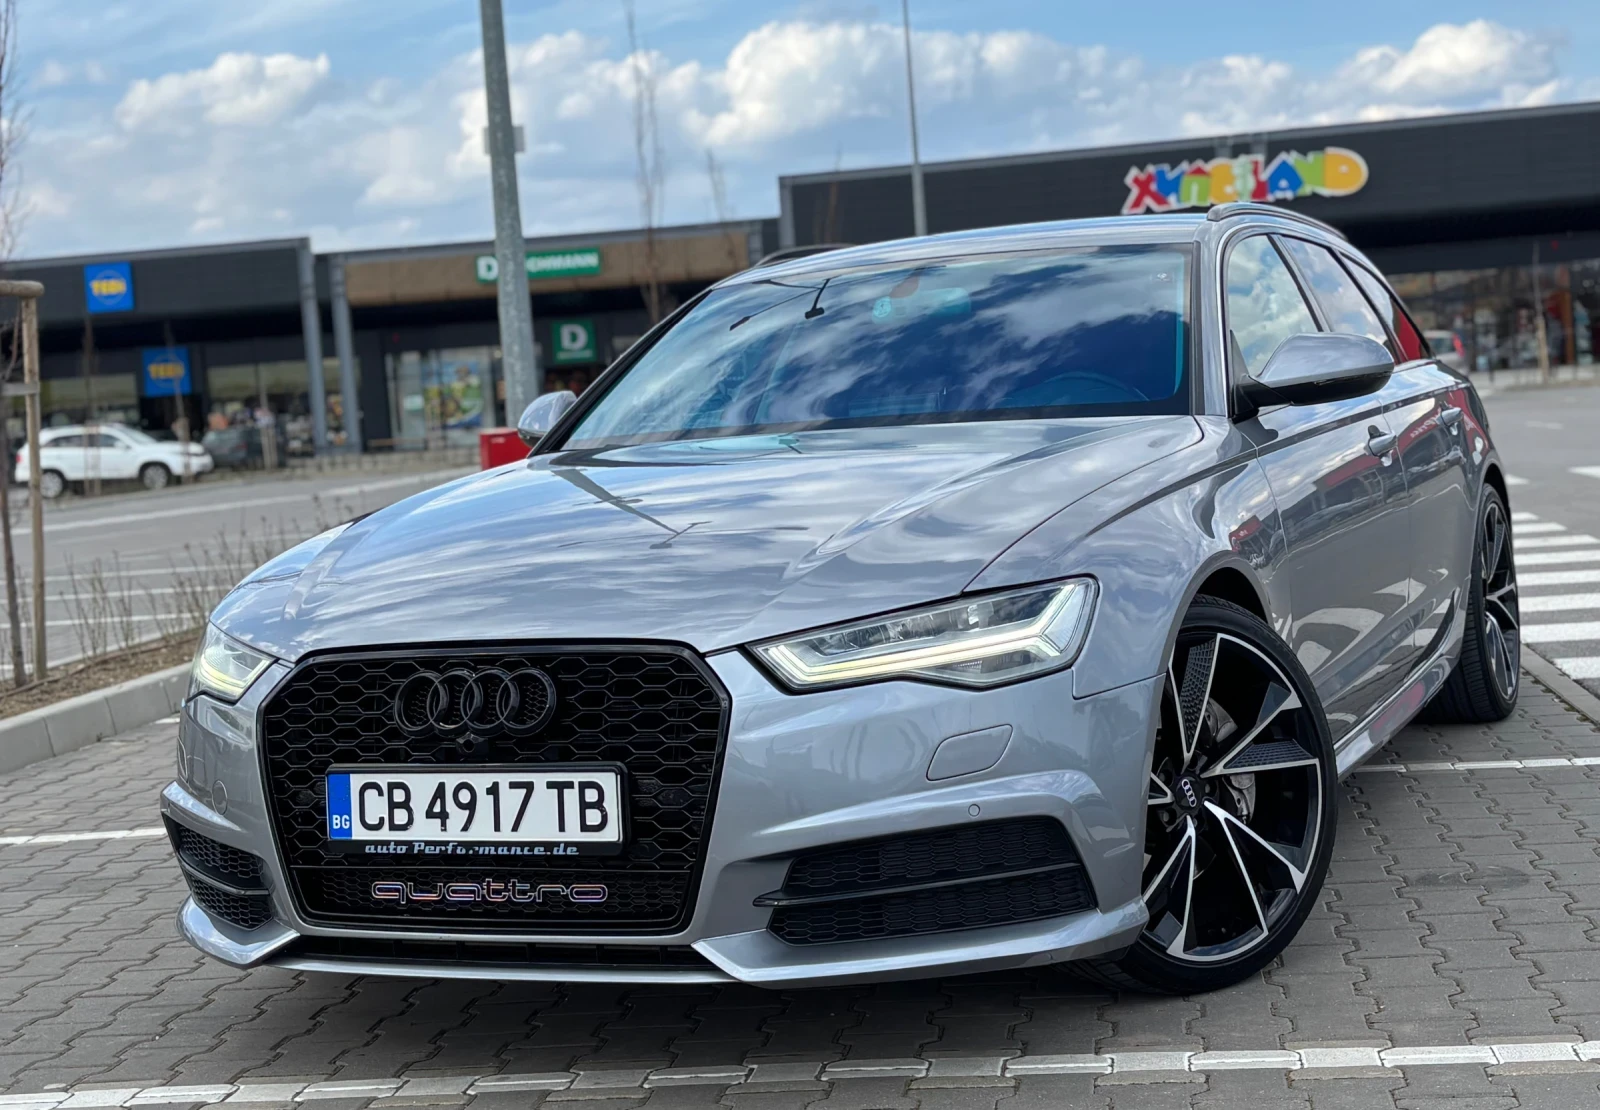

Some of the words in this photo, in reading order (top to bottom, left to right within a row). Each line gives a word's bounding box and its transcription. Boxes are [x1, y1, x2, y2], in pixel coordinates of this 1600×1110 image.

[560, 323, 588, 351] D
[358, 781, 414, 831] CB
[425, 781, 535, 832] 4917
[546, 781, 608, 832] TB
[332, 815, 350, 829] BG
[365, 841, 408, 854] auto
[371, 878, 608, 904] quattro
